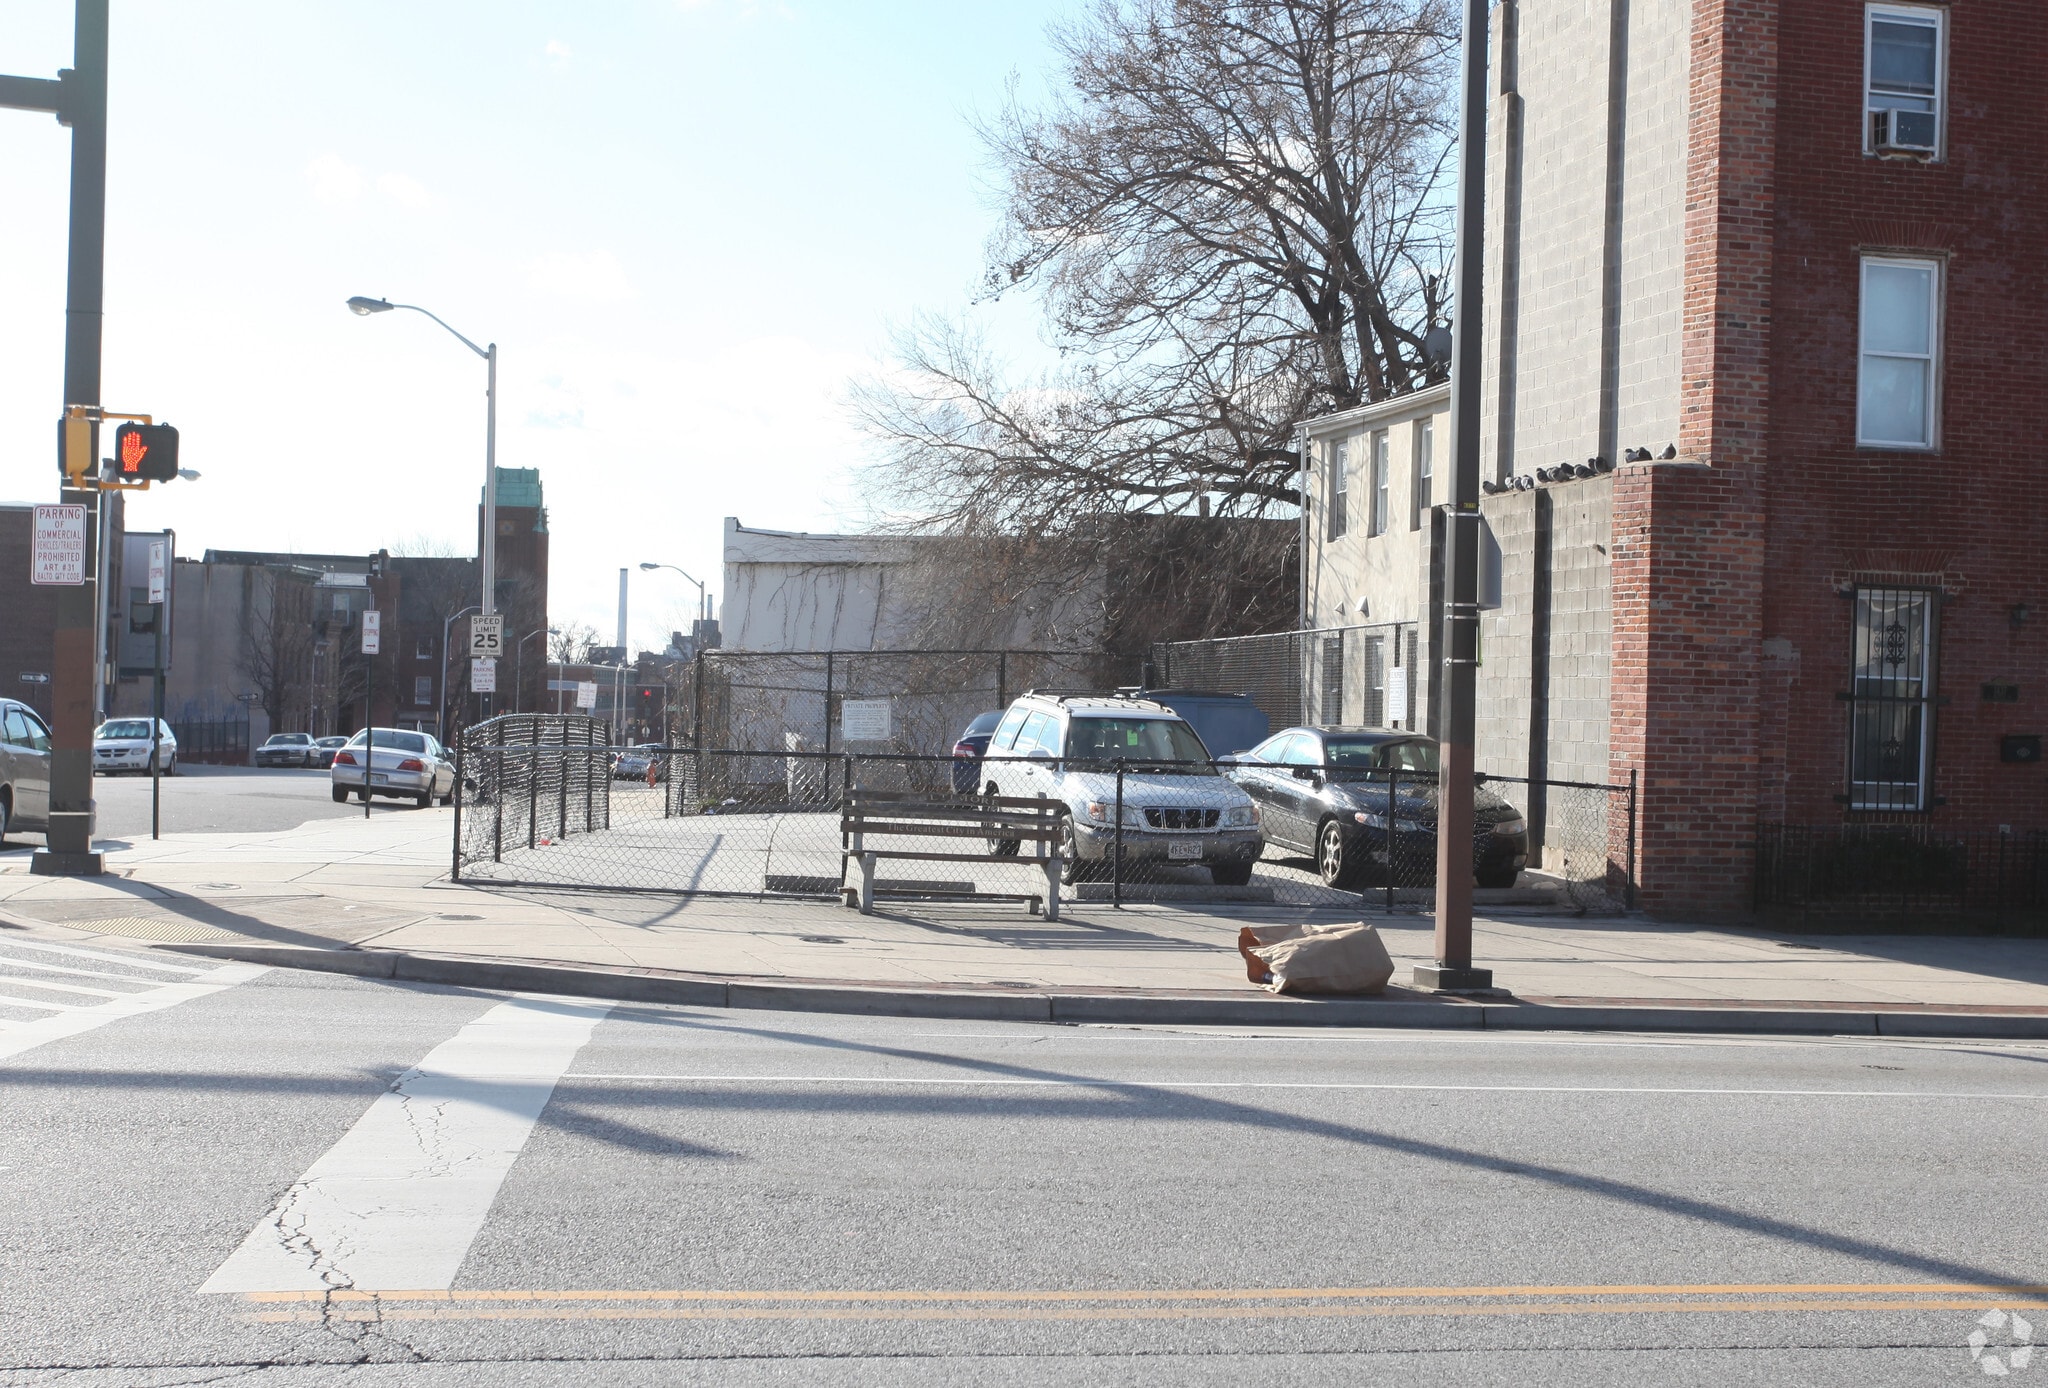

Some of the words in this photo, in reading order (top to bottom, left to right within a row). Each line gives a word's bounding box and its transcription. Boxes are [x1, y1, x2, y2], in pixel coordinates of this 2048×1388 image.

[39, 508, 80, 519] PARKING
[54, 520, 65, 528] OF
[37, 530, 81, 539] COMMERCIAL
[37, 541, 82, 550] VEHICLES/TRAILERS
[38, 552, 80, 561] PROHIBITED
[62, 564, 75, 572] #31
[368, 615, 375, 624] NO
[473, 617, 501, 625] SPEED
[474, 634, 499, 648] 25
[905, 824, 944, 833] Greatest
[946, 826, 965, 837] City
[977, 828, 1016, 837] America
